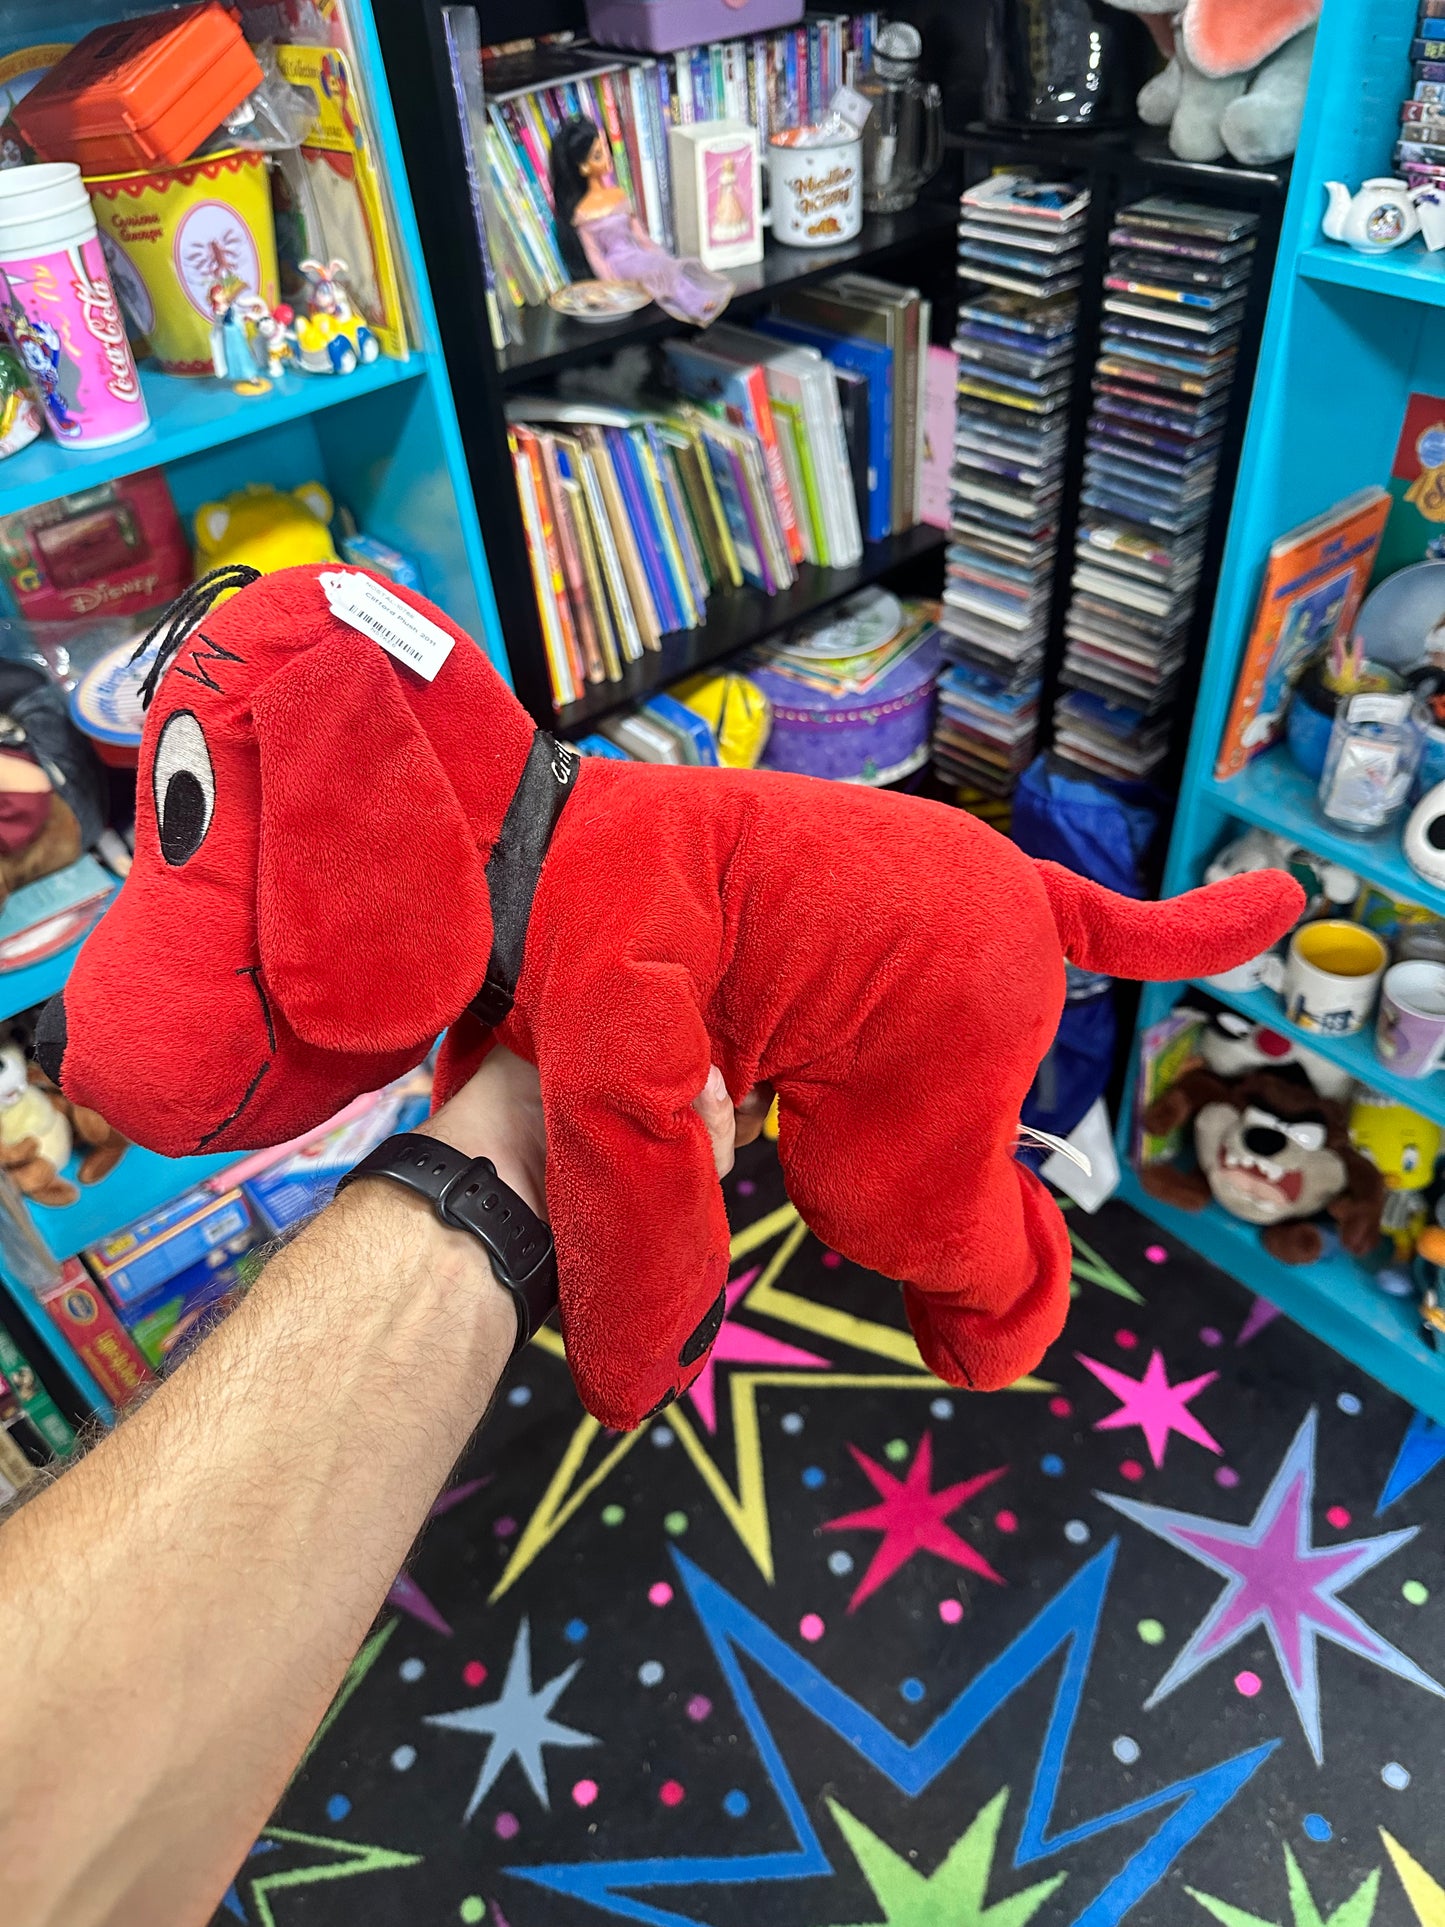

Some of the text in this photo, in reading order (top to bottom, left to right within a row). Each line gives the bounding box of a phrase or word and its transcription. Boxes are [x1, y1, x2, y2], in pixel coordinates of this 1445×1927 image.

[61, 574, 160, 614] Disney
[365, 592, 437, 647] Clifford Plush 2011
